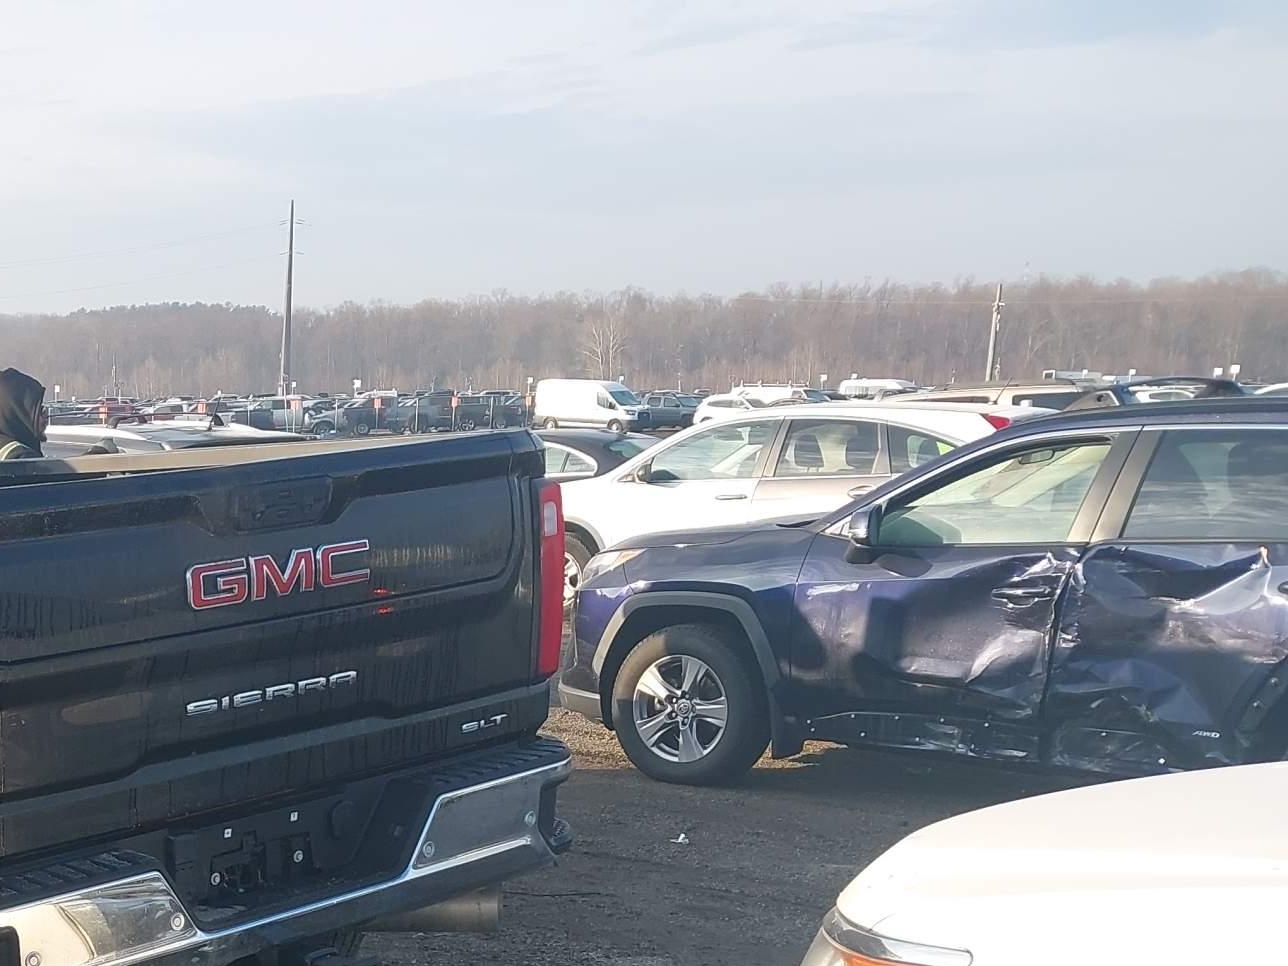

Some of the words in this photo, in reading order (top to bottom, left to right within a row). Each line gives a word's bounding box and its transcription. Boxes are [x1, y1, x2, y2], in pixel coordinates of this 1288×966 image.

[186, 539, 370, 610] GMC
[185, 670, 358, 716] SIERRA
[461, 714, 508, 735] SLT
[1192, 730, 1220, 738] AWD
